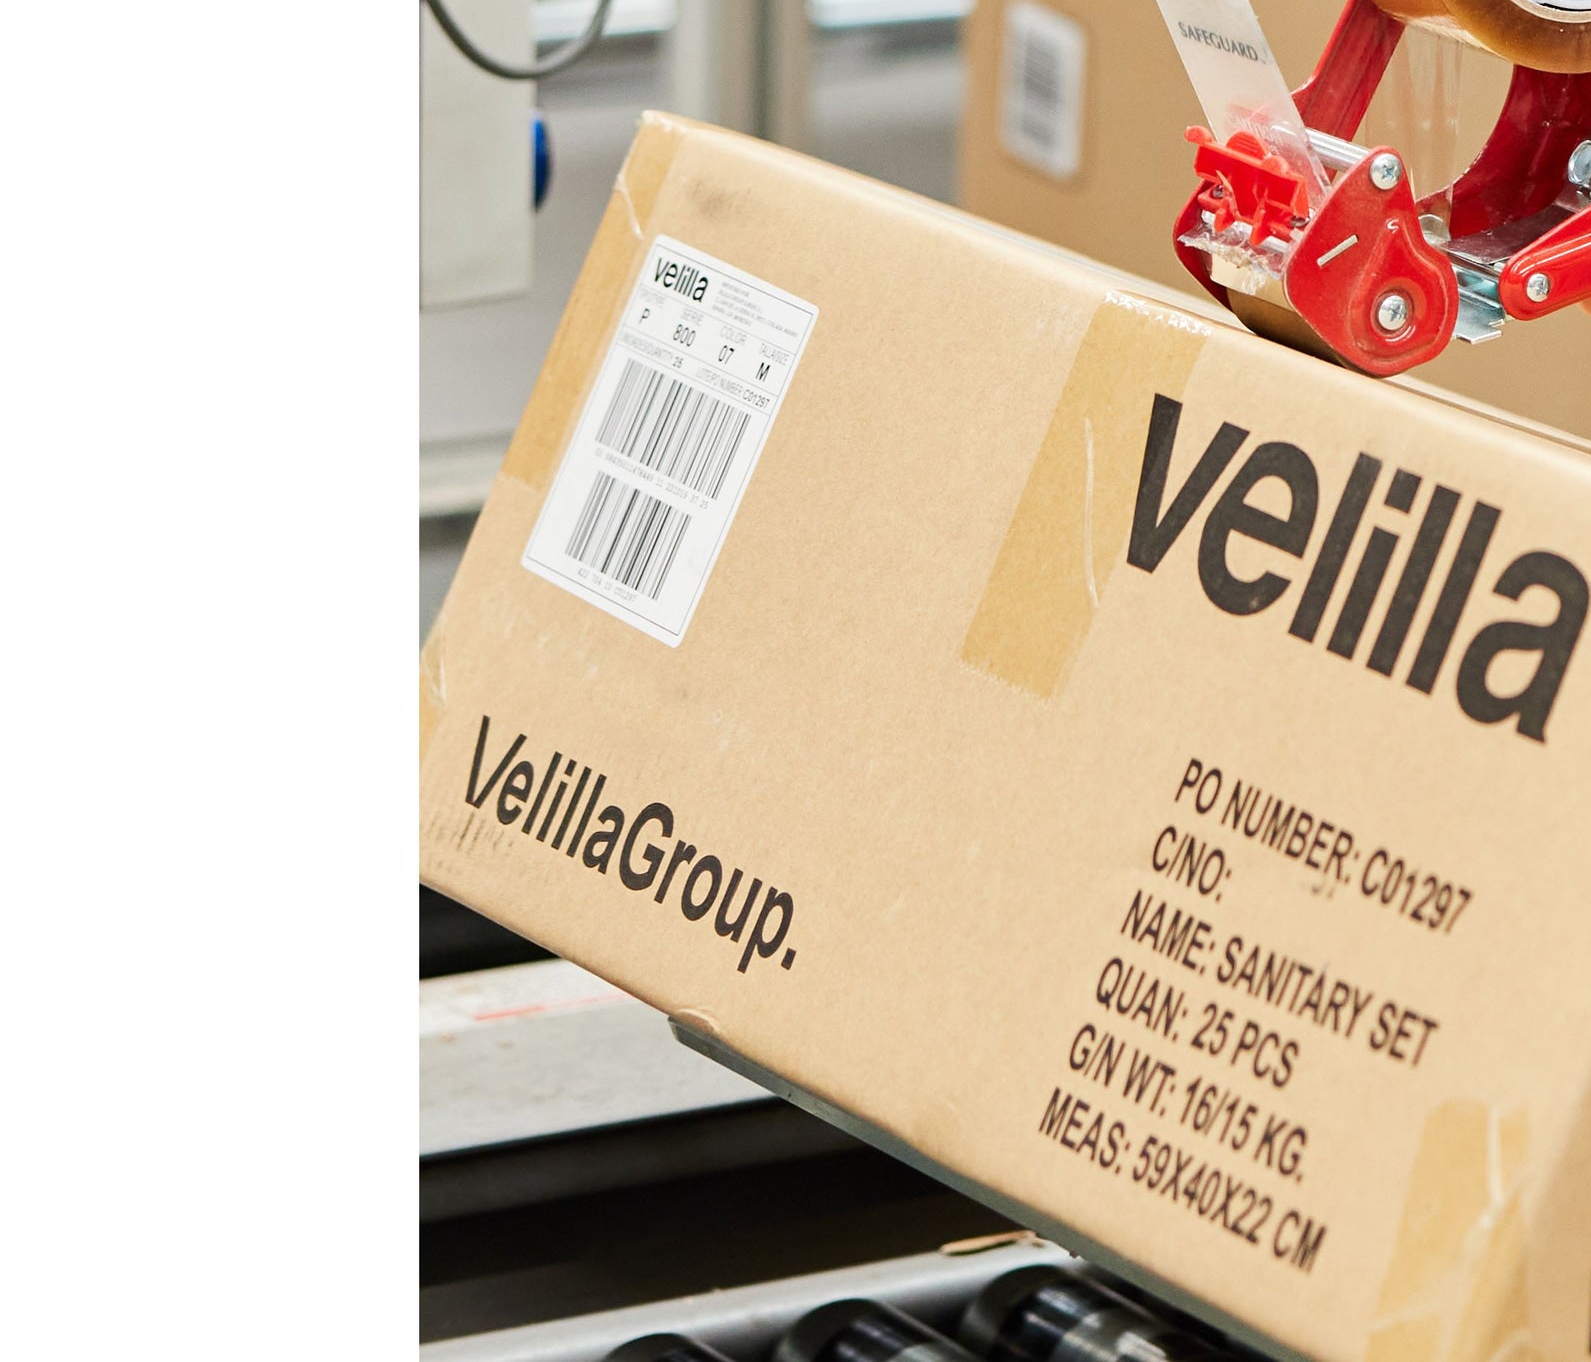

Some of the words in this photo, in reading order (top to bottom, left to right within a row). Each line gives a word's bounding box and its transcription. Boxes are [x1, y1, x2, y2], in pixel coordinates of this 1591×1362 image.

[1177, 20, 1260, 63] SAFEGUARD
[637, 306, 651, 324] P
[671, 322, 696, 347] 800
[717, 344, 735, 364] 07
[754, 361, 771, 382] M
[653, 256, 709, 303] velilla
[671, 355, 684, 369] 25
[742, 388, 770, 409] C01297
[1127, 392, 1591, 745] velilla
[465, 715, 798, 974] VelillaGroup.
[1152, 826, 1232, 901] C/NO:
[1175, 757, 1223, 816] PO
[1221, 780, 1360, 882] NUMBER:
[1361, 848, 1472, 935] C01297
[1096, 957, 1189, 1041] QUAN:
[1191, 1003, 1235, 1056] 25
[1231, 1020, 1299, 1089] PCS
[1120, 889, 1216, 974] NAME:
[1217, 936, 1374, 1035] SANITARY
[1370, 1002, 1438, 1067] SET
[1069, 1024, 1126, 1087] G/N
[1123, 1049, 1178, 1117] WT:
[1181, 1077, 1258, 1151] 16/15
[1253, 1118, 1307, 1182] KG.
[1039, 1088, 1132, 1175] MEAS:
[1132, 1135, 1273, 1245] 59X40X22
[1272, 1210, 1327, 1271] CM
